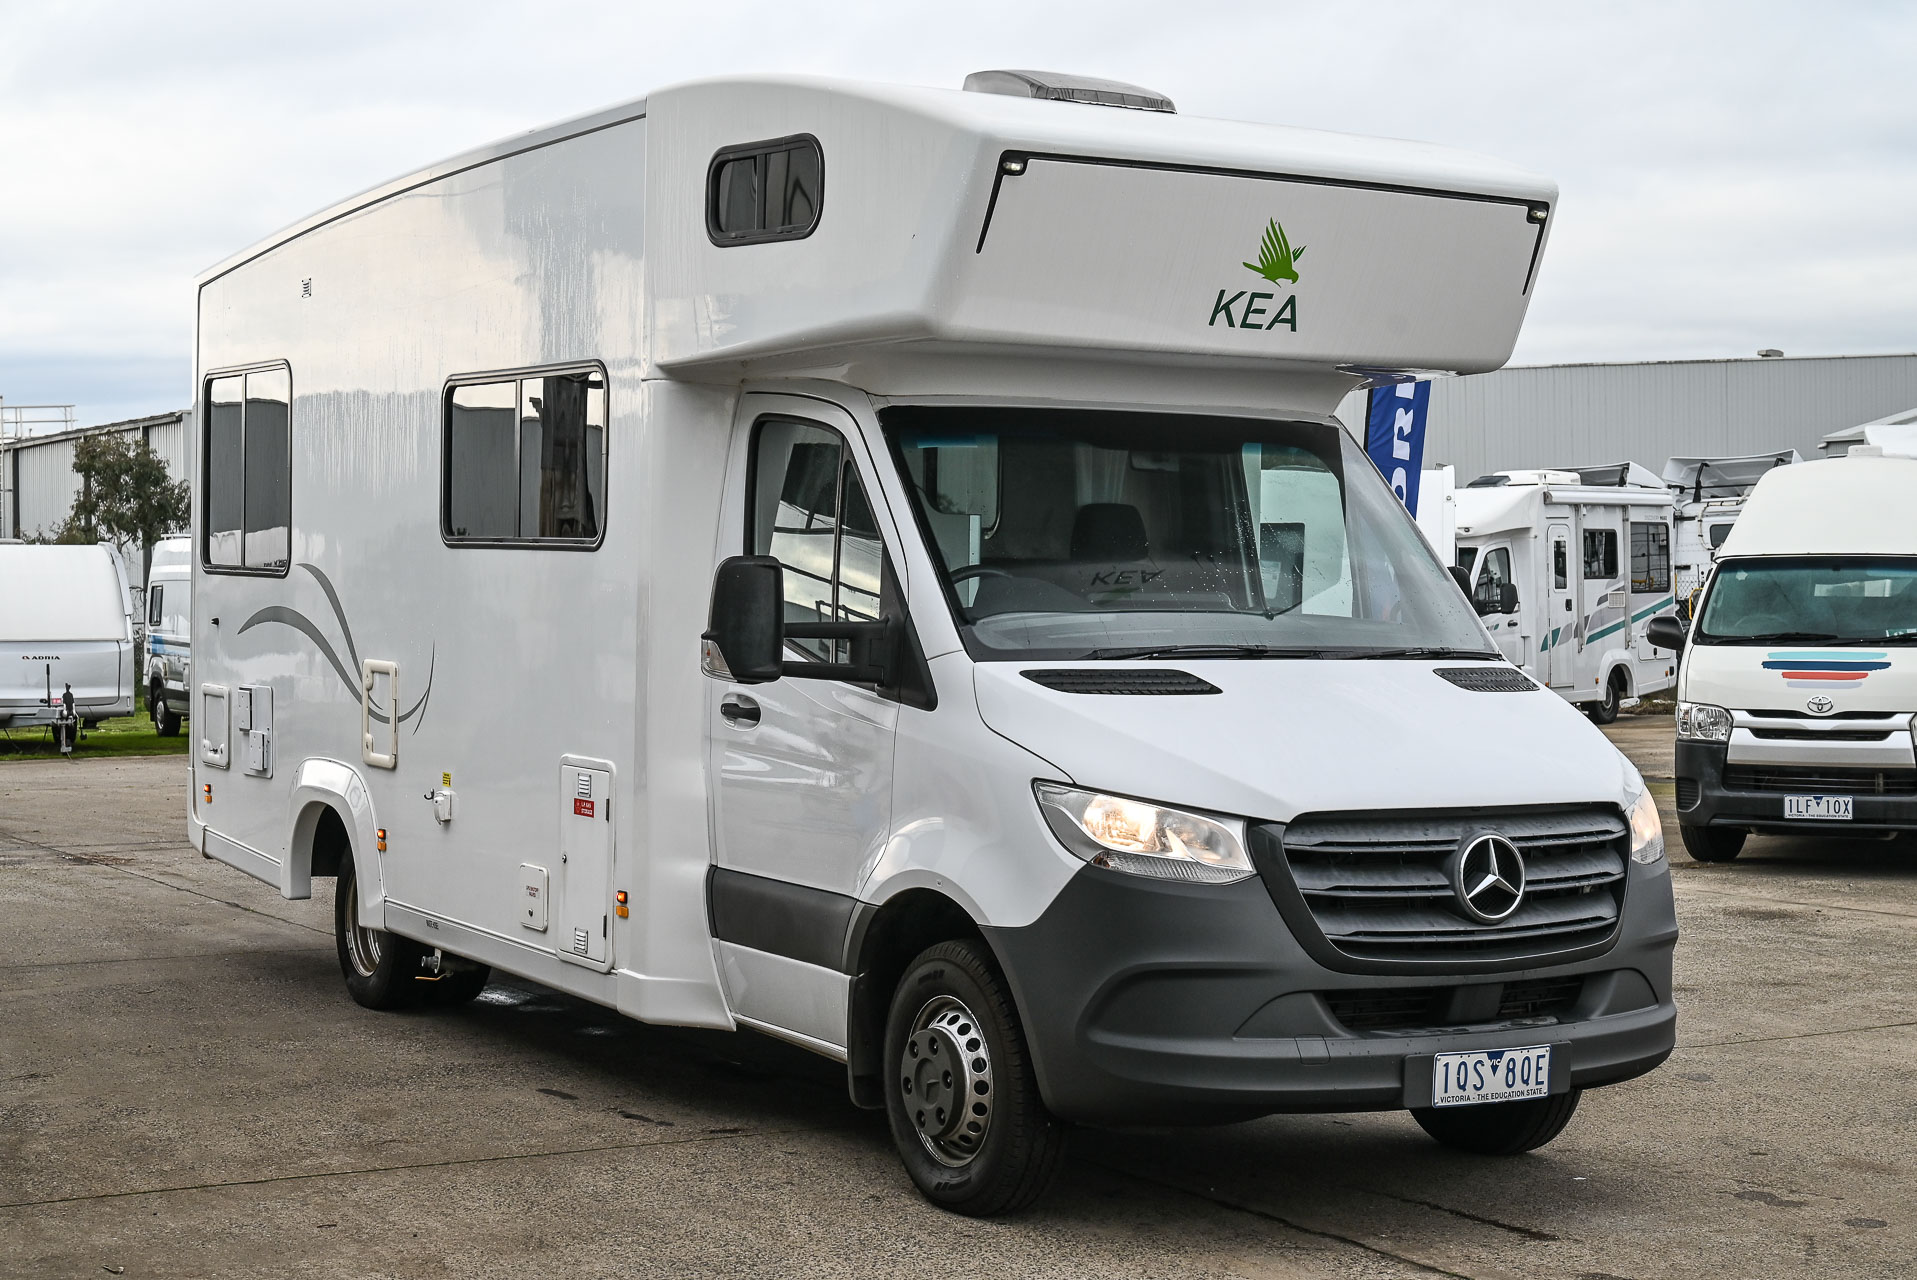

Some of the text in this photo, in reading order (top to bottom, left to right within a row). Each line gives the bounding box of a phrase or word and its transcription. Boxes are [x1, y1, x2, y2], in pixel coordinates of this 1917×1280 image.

[1208, 288, 1297, 333] KEA
[1788, 799, 1850, 815] 1LF 10X
[1443, 1054, 1546, 1093] 1QS 8QE
[1440, 1094, 1471, 1103] VICTORIA
[1477, 1093, 1490, 1101] THE
[1491, 1089, 1525, 1100] EDUCATION
[1526, 1087, 1543, 1096] STATE
